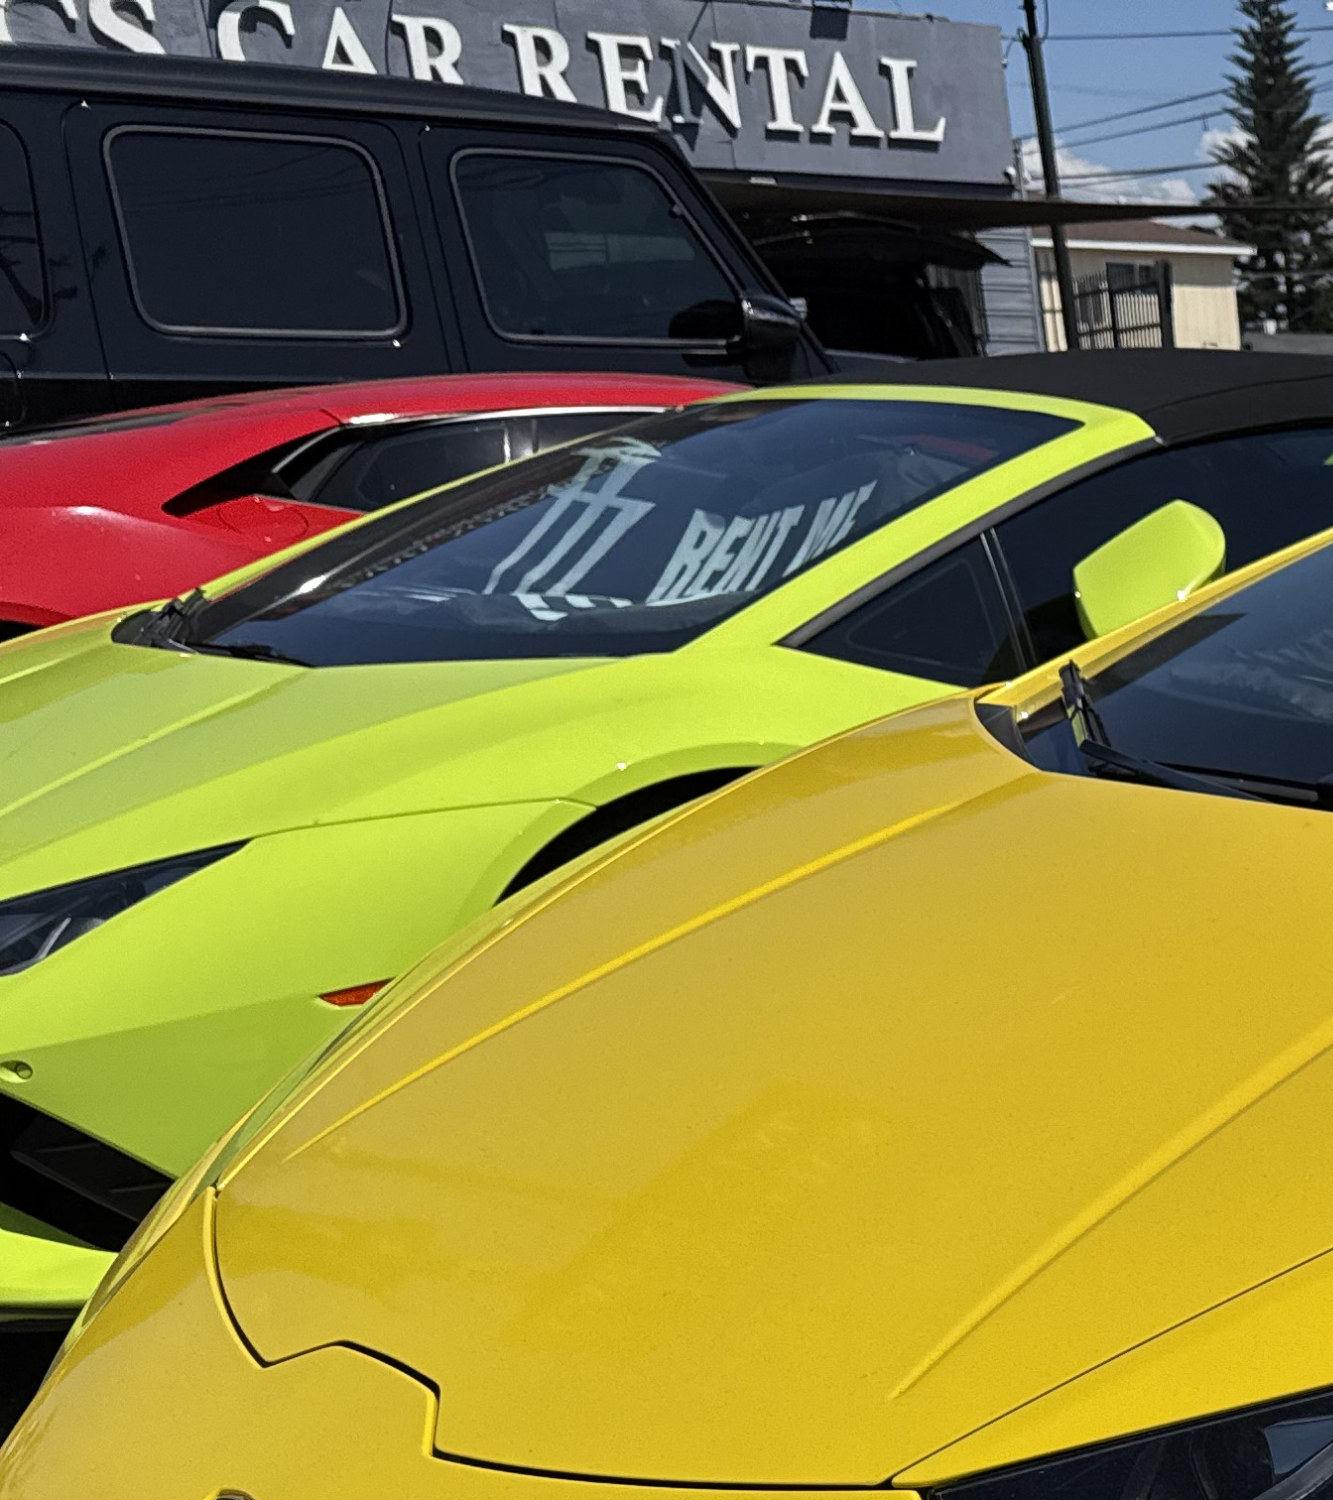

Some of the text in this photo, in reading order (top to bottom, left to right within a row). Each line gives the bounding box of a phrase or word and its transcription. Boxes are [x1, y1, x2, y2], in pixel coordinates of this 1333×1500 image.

[217, 0, 464, 85] CAR
[502, 23, 947, 142] RENTAL
[645, 504, 806, 607] RENT
